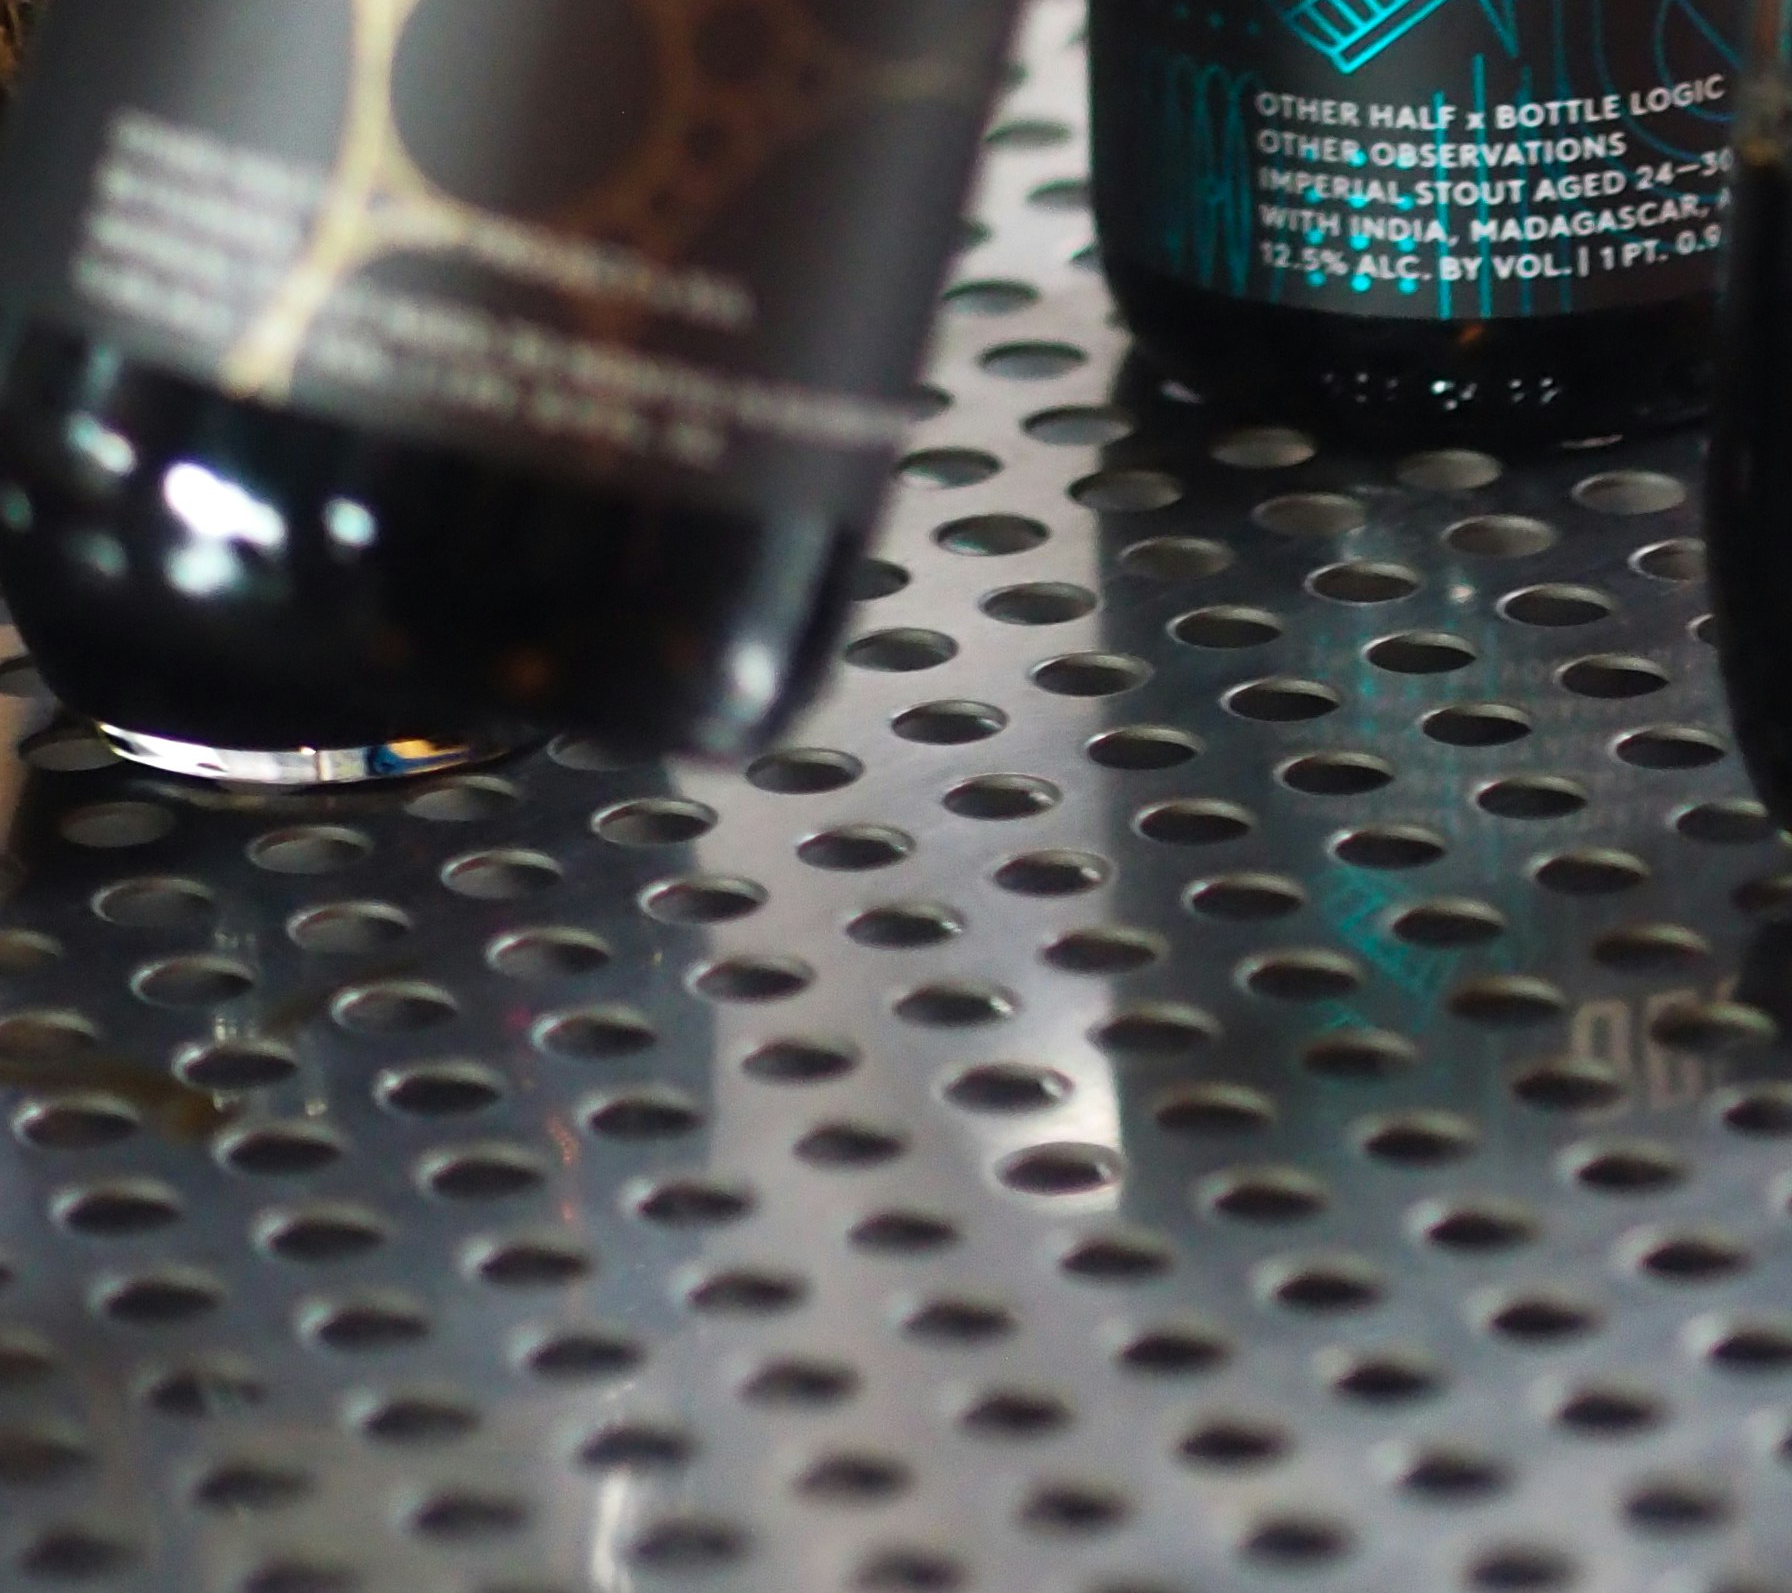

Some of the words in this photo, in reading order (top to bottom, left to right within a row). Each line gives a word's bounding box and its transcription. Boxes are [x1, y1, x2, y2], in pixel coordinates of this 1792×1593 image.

[1255, 92, 1360, 127] OTHER
[1369, 103, 1456, 130] HALF
[1494, 94, 1621, 129] BOTTLE
[1630, 73, 1725, 116] LOGIC
[1257, 128, 1364, 164] OTHER
[1369, 132, 1628, 168] OBSERVATIONS
[1258, 167, 1403, 205] IMPERIAL
[1414, 178, 1526, 206] STOUT
[1533, 170, 1627, 202] AGED
[1258, 204, 1341, 237] WITH
[1350, 214, 1460, 247] INDIA,
[1470, 193, 1710, 242] MADAGASCAR,
[1259, 241, 1348, 276] 12.5%
[1358, 254, 1432, 280] ALC.
[1440, 256, 1483, 282] BY
[1491, 254, 1572, 280] VOL.
[1621, 238, 1669, 268] PT.
